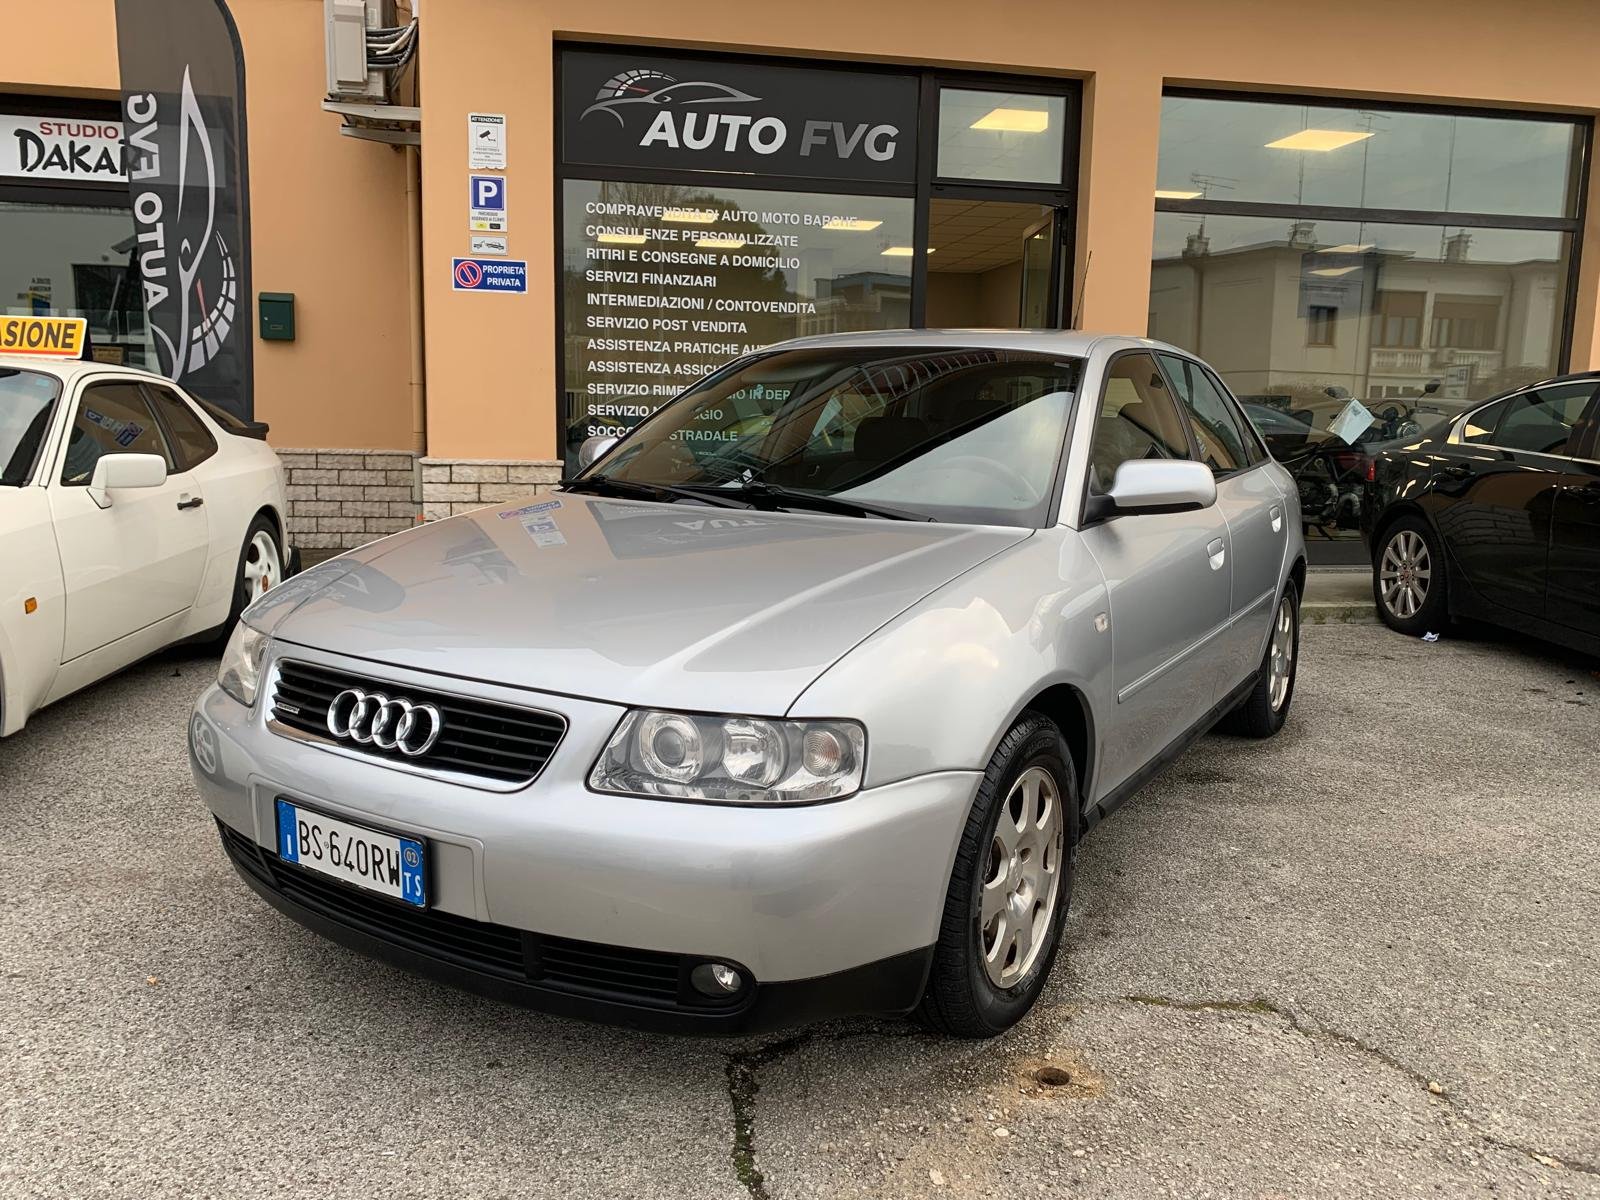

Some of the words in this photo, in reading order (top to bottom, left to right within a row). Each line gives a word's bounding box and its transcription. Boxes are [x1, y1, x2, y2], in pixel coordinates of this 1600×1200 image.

[39, 121, 119, 139] STUDIO
[639, 110, 787, 155] AUTO
[800, 119, 899, 162] FVG
[479, 180, 498, 206] P
[585, 202, 700, 219] COMPRAVENDITA
[721, 209, 758, 223] AUTO
[762, 212, 800, 225] MOTO
[585, 225, 679, 241] CONSULENZE
[682, 230, 799, 247] PERSONALIZZATE
[586, 248, 625, 261] RITIRI
[629, 250, 637, 262] E
[641, 251, 717, 266] CONSEGNE
[720, 254, 730, 267] A
[732, 255, 800, 269] DOMICILIO
[486, 277, 521, 287] PRIVATA
[586, 270, 638, 284] SERVIZI
[642, 273, 717, 288] FINANZIARI
[587, 293, 704, 309] INTERMEDIAZIONI
[707, 298, 713, 311] /
[715, 300, 816, 314] CONTOVENDITA
[586, 316, 649, 330] SERVIZIO
[653, 319, 689, 332] POST
[692, 320, 747, 333] VENDITA
[0, 320, 77, 349] SIONE
[587, 338, 671, 353] ASSISTENZA
[674, 341, 739, 355] PRATICHE
[587, 360, 671, 375] ASSISTENZA
[587, 383, 649, 395] SERVIZIO
[587, 404, 649, 417] SERVIZIO
[669, 429, 738, 441] STRADALE
[286, 834, 292, 855] I
[298, 820, 323, 860] BS
[406, 848, 417, 864] 02
[403, 871, 422, 897] TS
